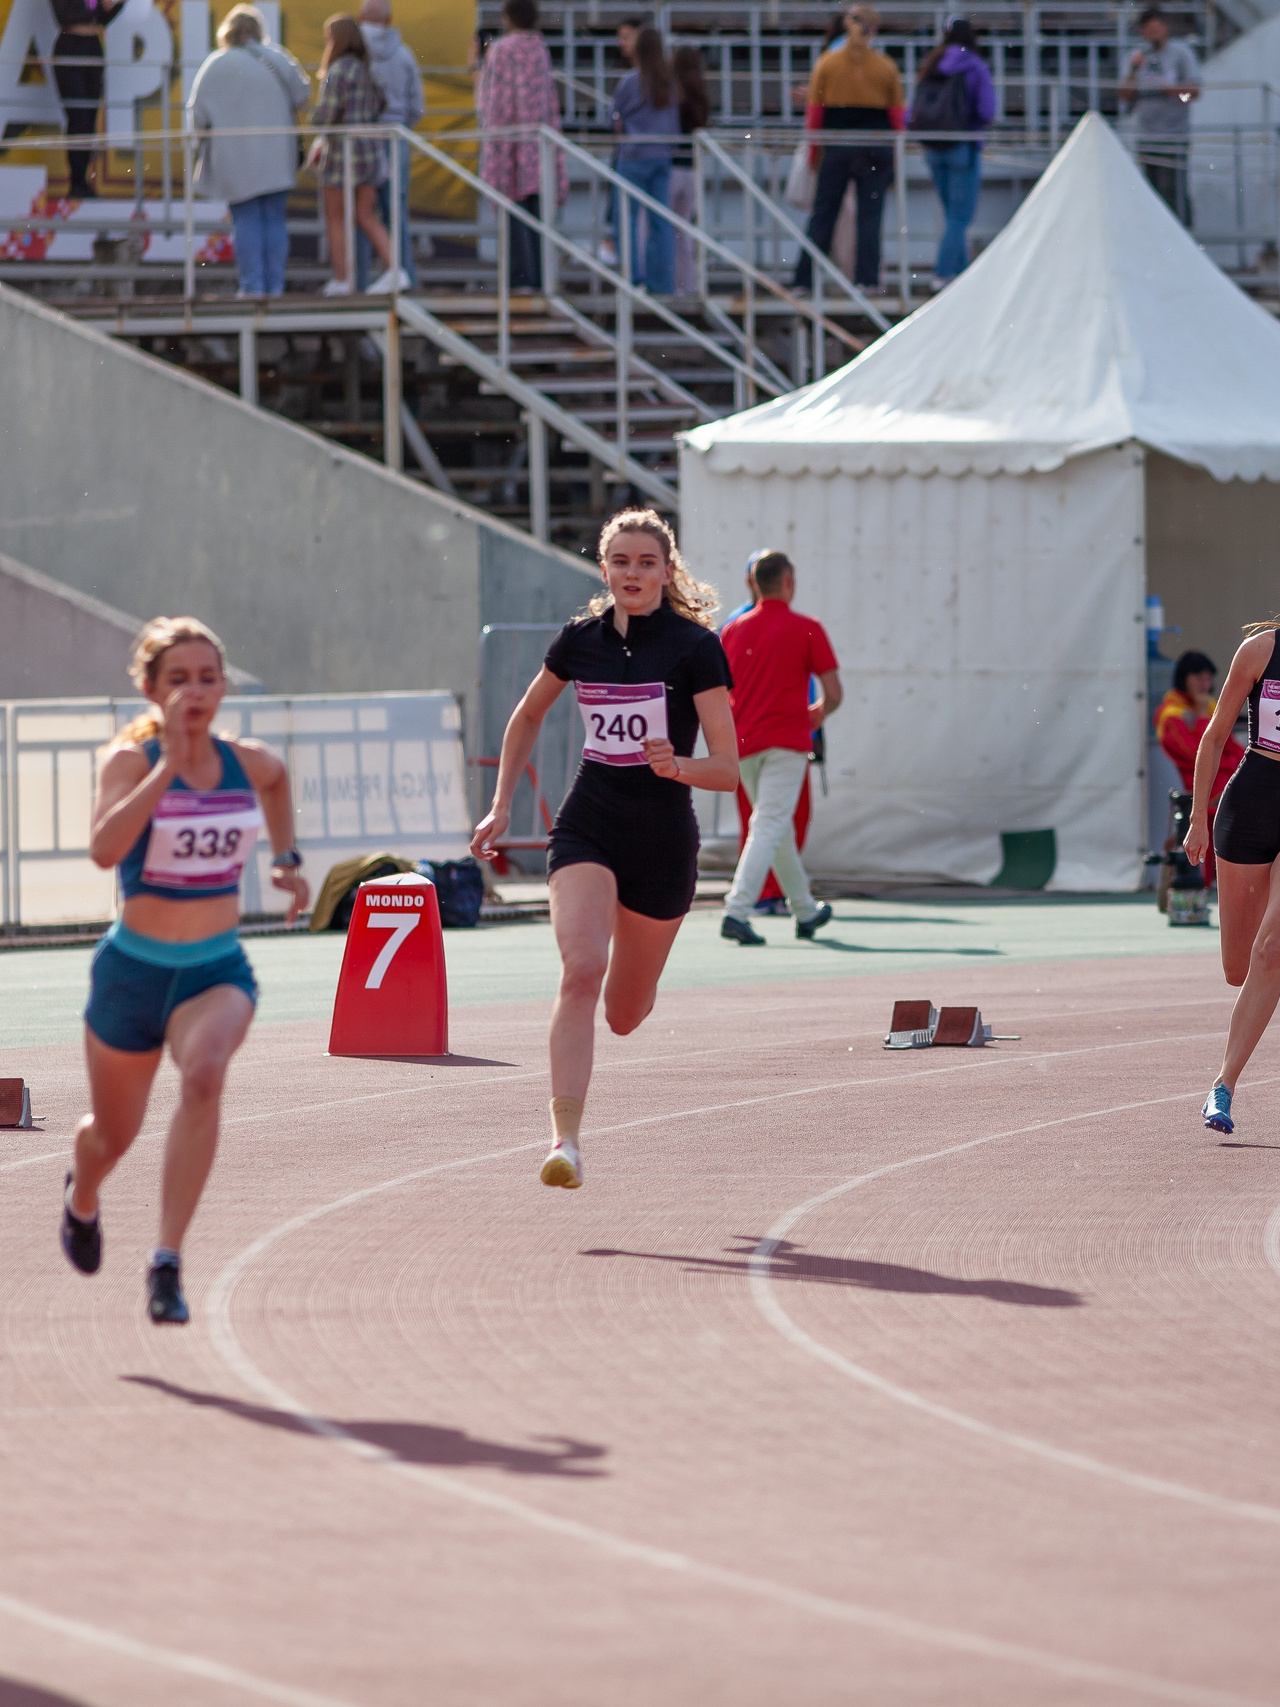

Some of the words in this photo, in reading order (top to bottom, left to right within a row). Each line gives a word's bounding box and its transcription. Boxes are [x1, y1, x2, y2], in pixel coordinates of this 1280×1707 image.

[590, 713, 648, 742] 240
[173, 826, 244, 859] 338
[366, 895, 425, 907] MONDO
[364, 912, 422, 990] 7
